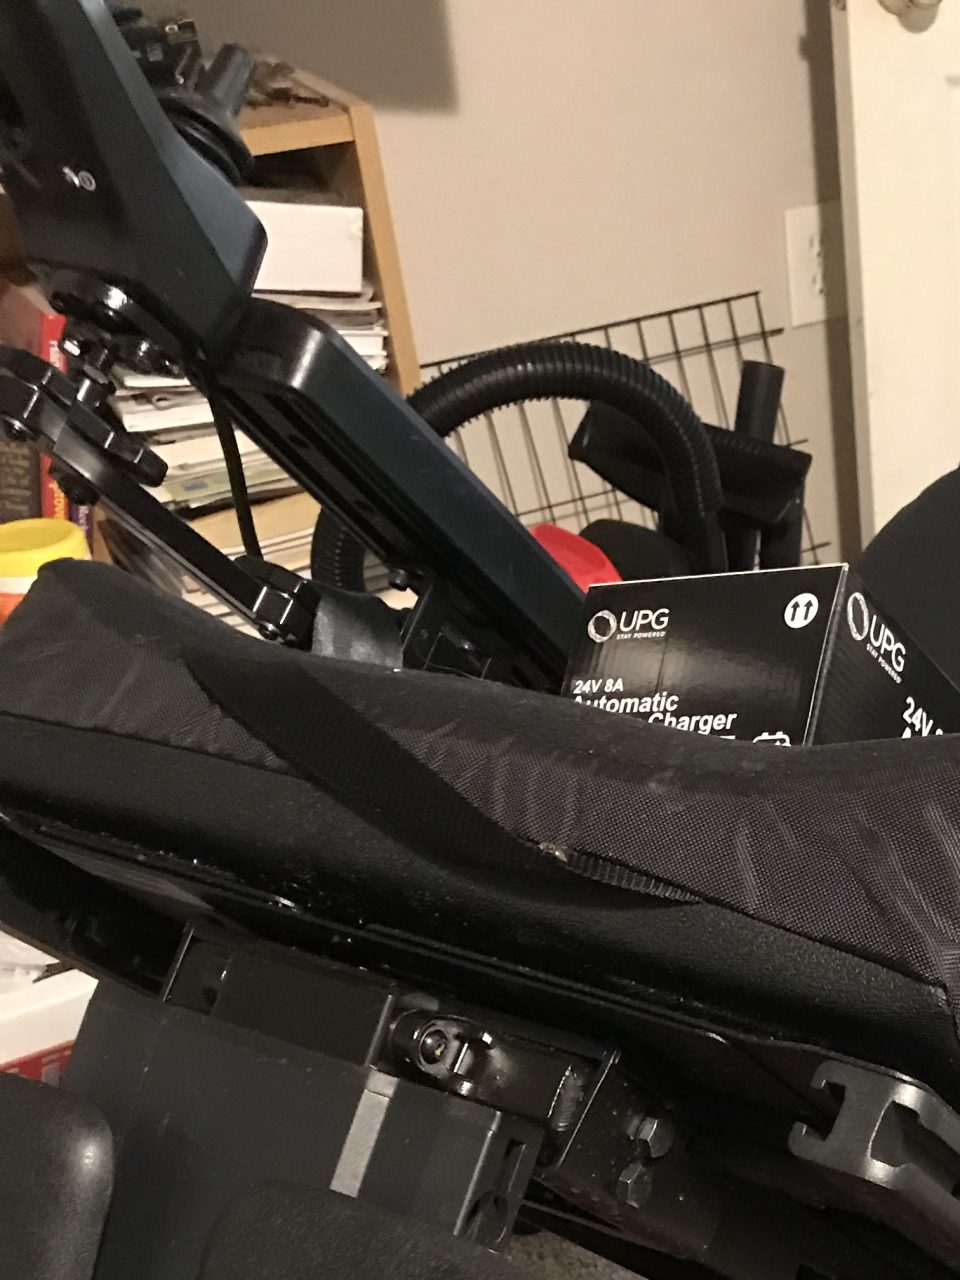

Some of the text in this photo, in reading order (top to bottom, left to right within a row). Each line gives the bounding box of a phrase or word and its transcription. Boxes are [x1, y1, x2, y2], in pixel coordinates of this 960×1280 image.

[619, 608, 670, 632] UPG
[616, 630, 666, 640] STAY POWERED
[869, 614, 907, 672] UPG
[573, 678, 624, 694] 24V 8A
[574, 691, 679, 714] tomatic
[902, 696, 934, 737] 24V
